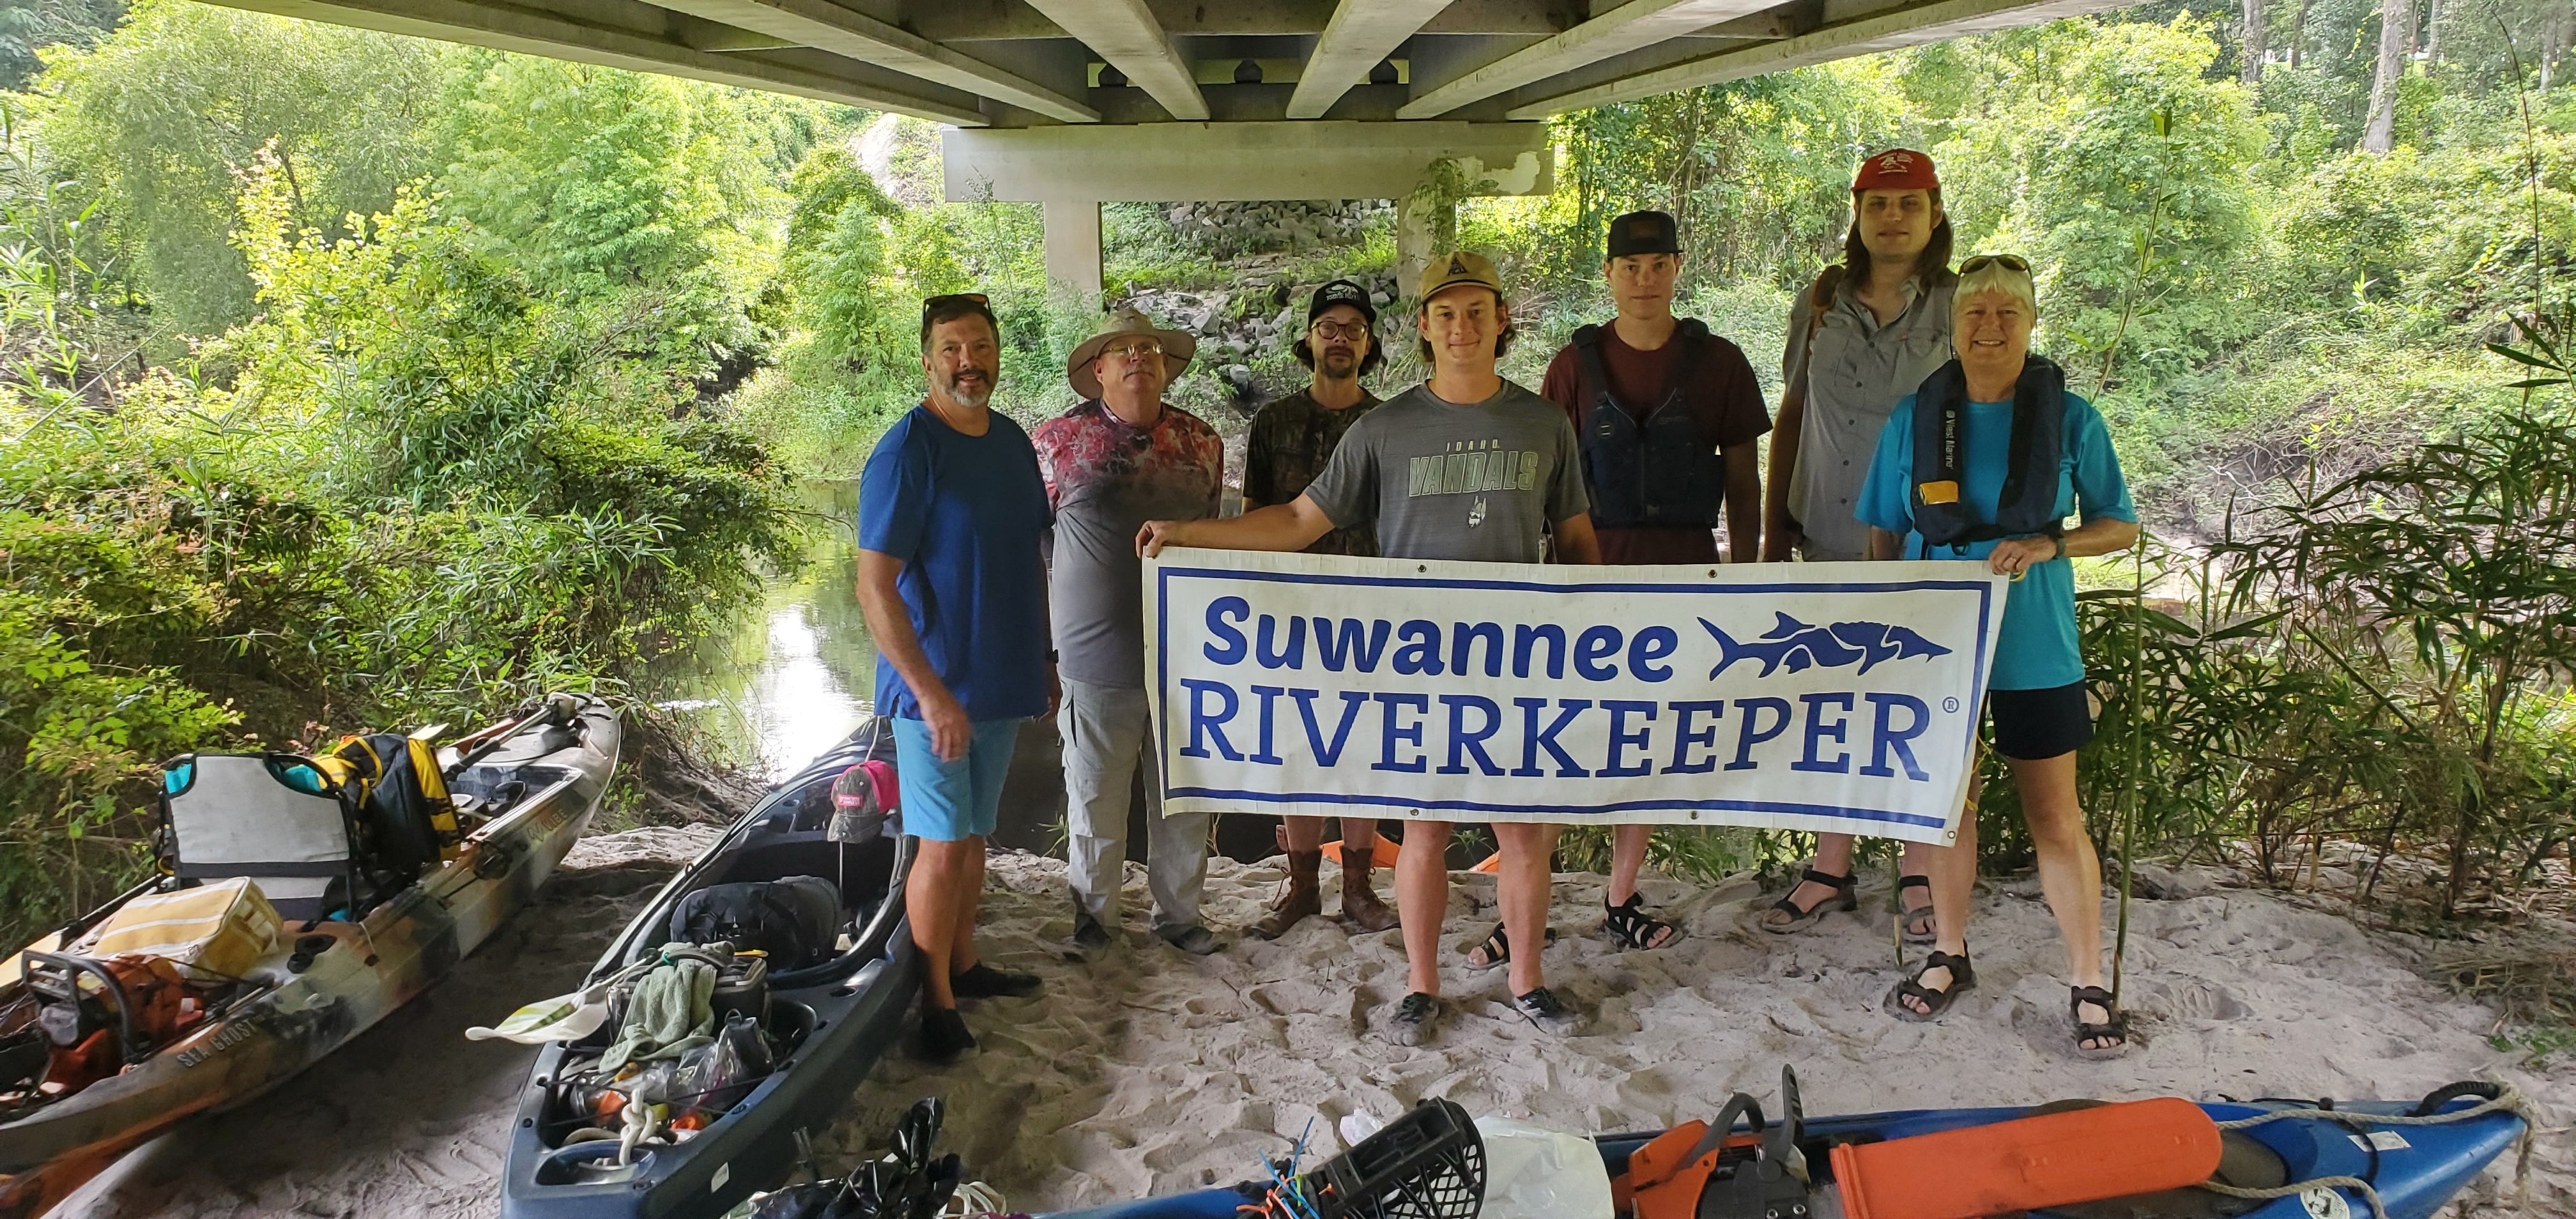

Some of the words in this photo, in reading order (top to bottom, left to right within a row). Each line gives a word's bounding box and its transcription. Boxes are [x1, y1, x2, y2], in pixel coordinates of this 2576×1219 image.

[1945, 418, 1956, 439] West
[1408, 450, 1538, 498] VANDALS
[1945, 440, 1956, 468] Marine
[1204, 595, 1678, 683] Suwannee
[177, 1045, 211, 1067] SEA
[208, 1018, 256, 1051] GHOST
